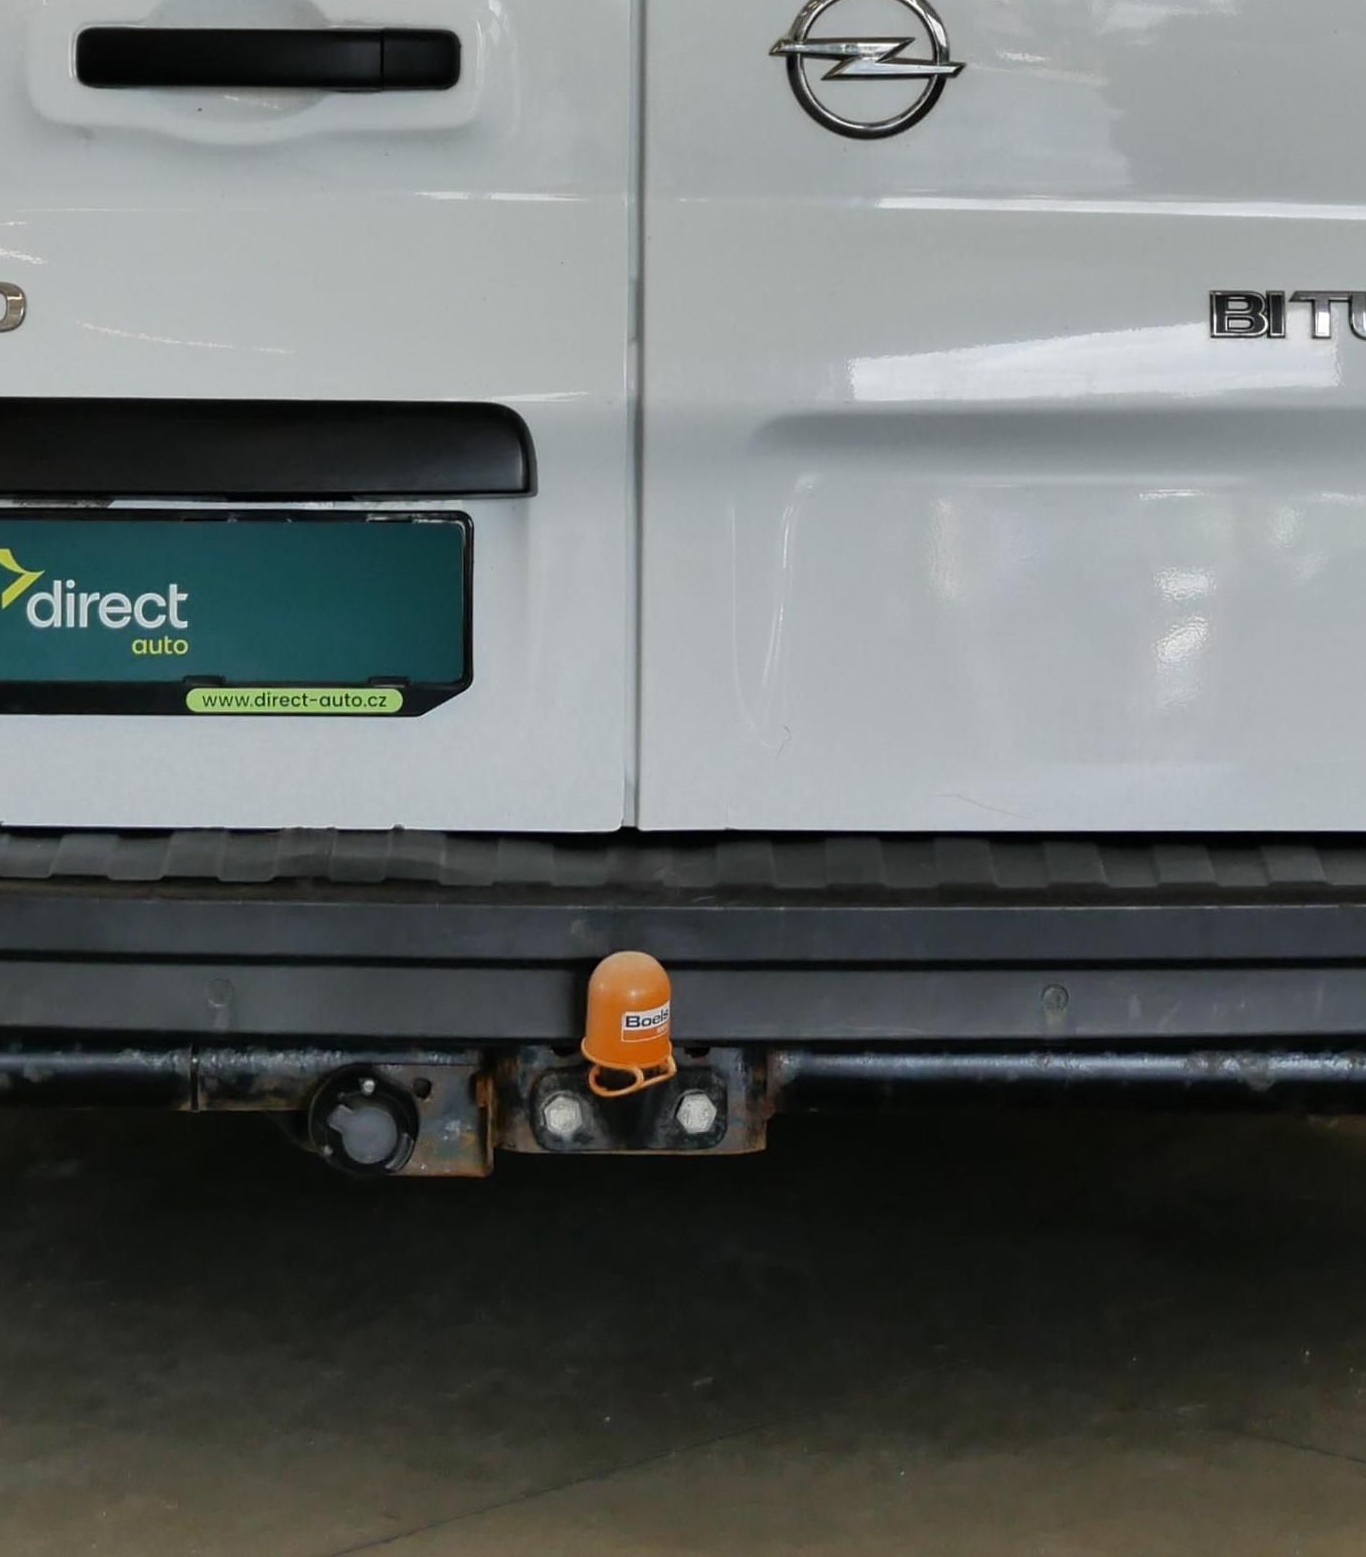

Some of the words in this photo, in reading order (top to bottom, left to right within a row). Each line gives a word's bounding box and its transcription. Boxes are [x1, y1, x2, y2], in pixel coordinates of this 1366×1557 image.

[26, 579, 189, 630] direct
[131, 636, 189, 656] auto
[202, 692, 387, 709] www.direct-auto.cz
